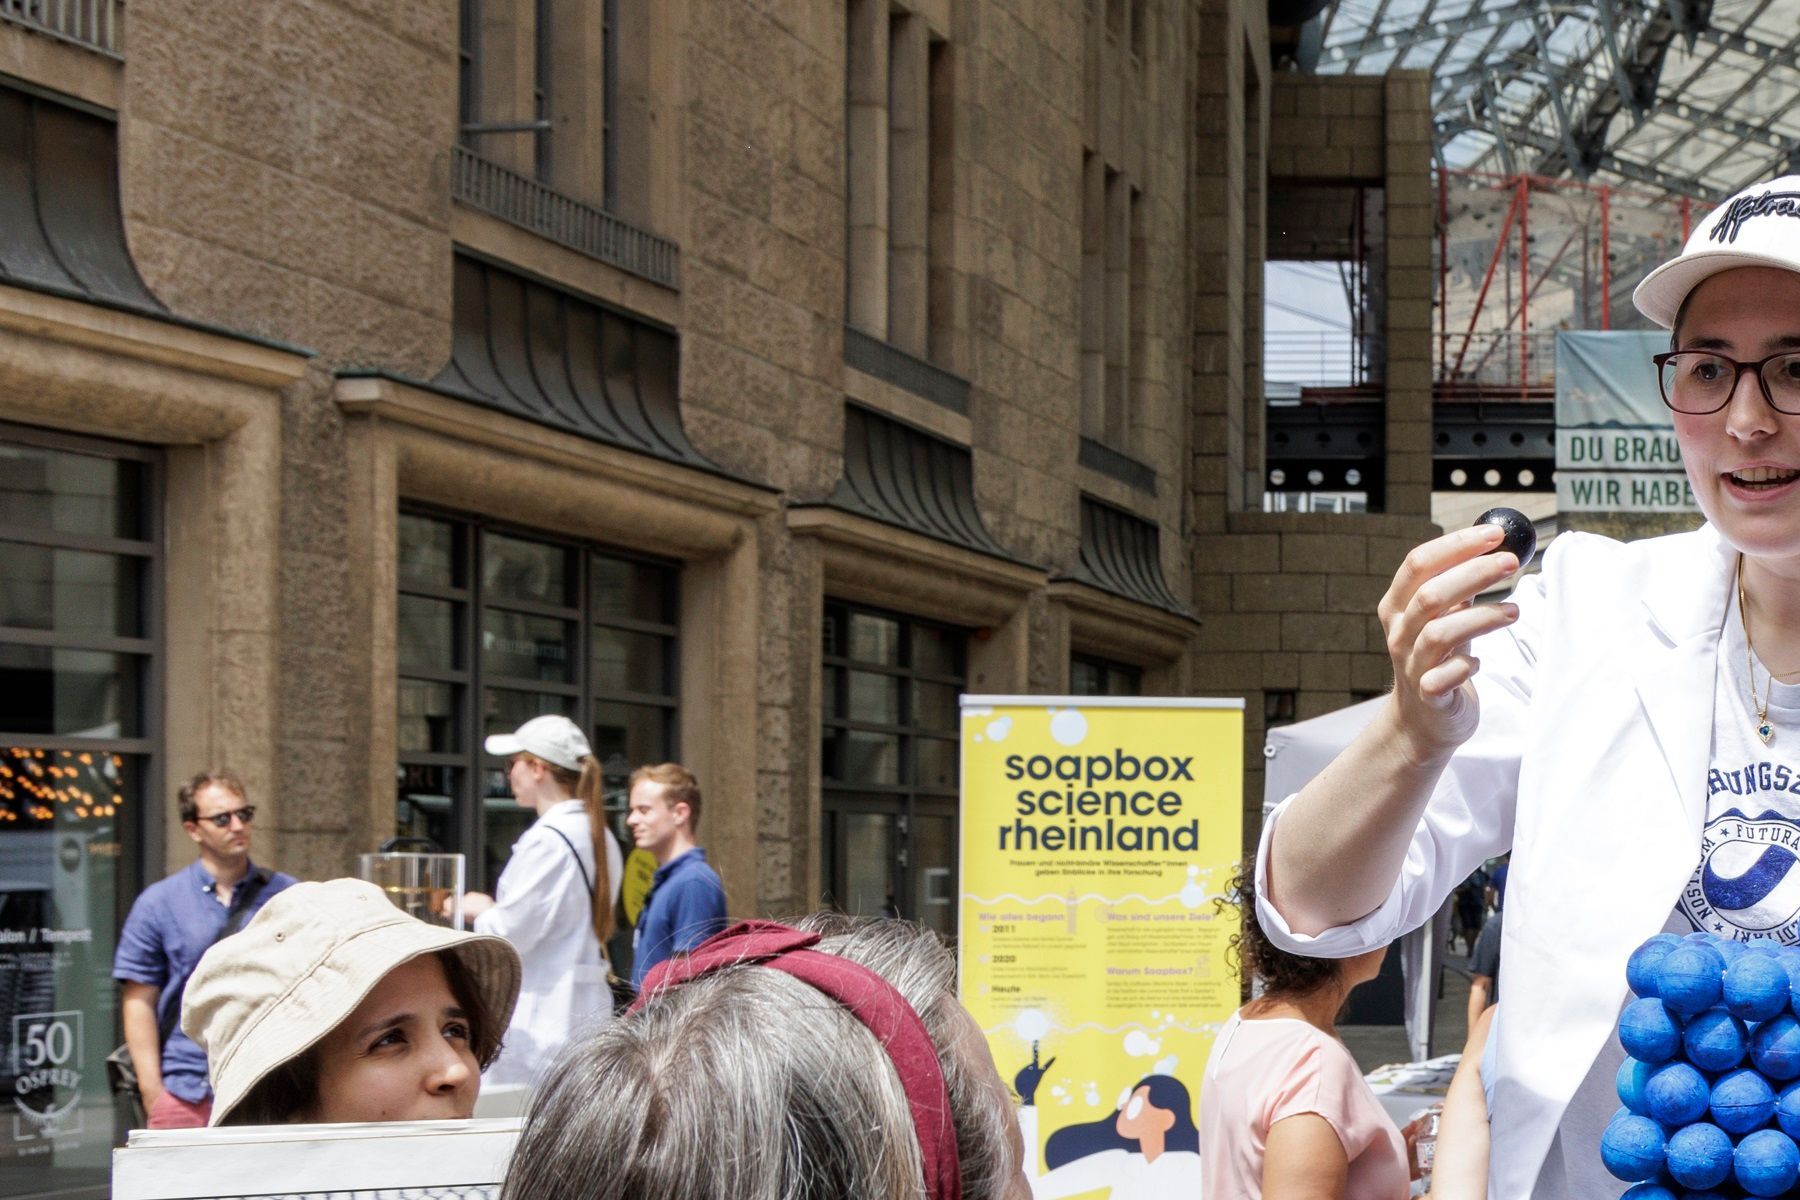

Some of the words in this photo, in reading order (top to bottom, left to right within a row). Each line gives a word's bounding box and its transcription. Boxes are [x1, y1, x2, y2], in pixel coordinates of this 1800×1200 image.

[1571, 436, 1603, 461] DU
[1615, 437, 1680, 462] BRAU
[1571, 480, 1620, 505] WIR
[1005, 748, 1194, 788] soapbox
[1016, 783, 1182, 816] science
[1000, 818, 1199, 851] rheinland
[1737, 824, 1799, 851] FUTURA
[992, 925, 1016, 933] 2011
[992, 955, 1016, 963] 2020
[26, 1021, 72, 1066] 50
[16, 1068, 81, 1094] OSPREY
